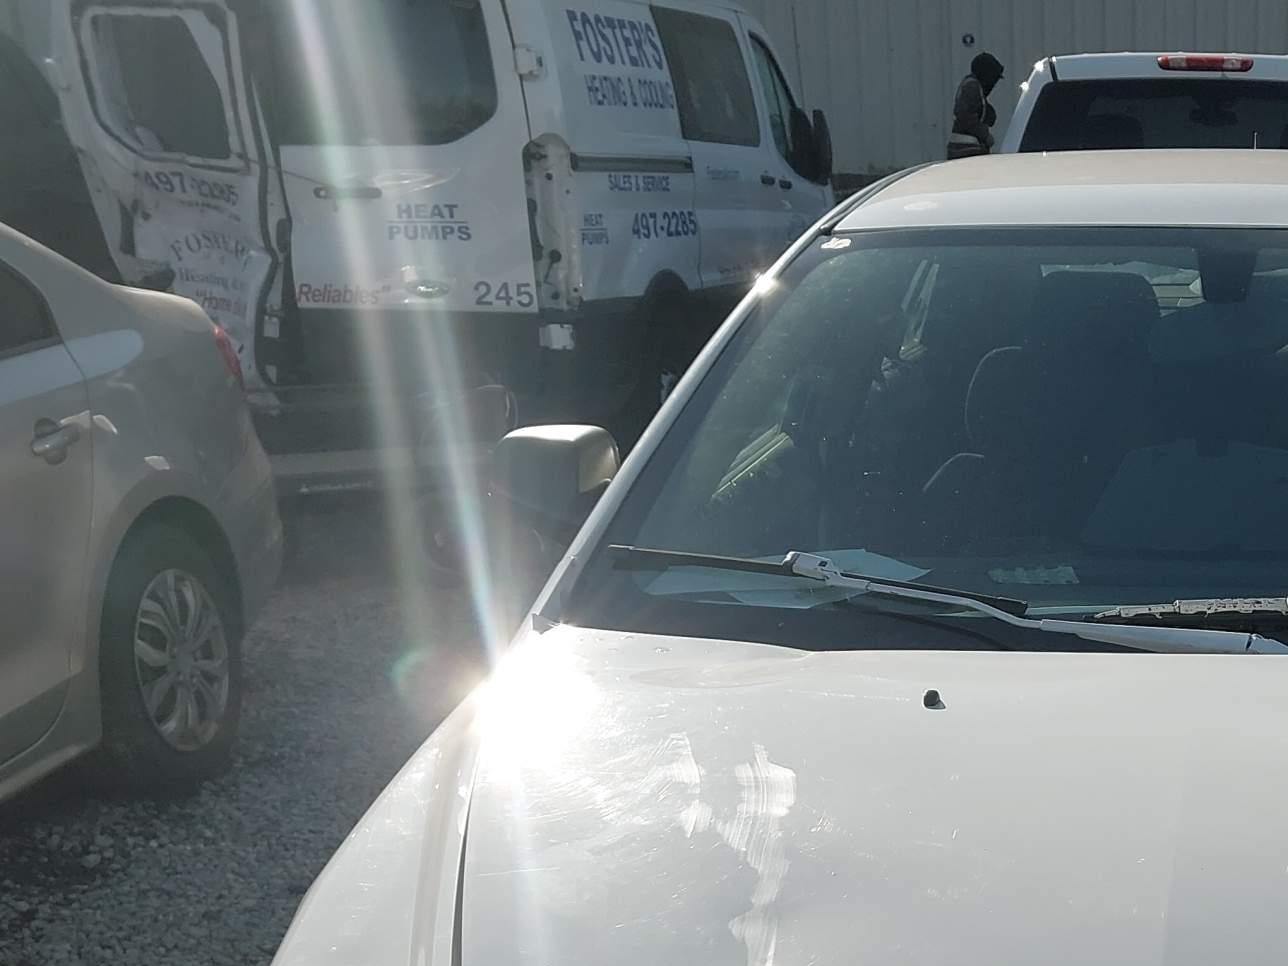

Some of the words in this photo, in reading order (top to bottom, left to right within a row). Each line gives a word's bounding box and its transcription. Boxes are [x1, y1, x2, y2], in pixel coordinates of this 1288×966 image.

[566, 9, 664, 70] FOSTER'S
[584, 75, 626, 107] HEATING
[638, 79, 674, 109] COOLING
[608, 174, 633, 191] SALES
[397, 204, 459, 219] HEAT
[631, 210, 698, 239] 497-2285
[388, 226, 473, 241] PUMPS
[473, 281, 535, 308] 245
